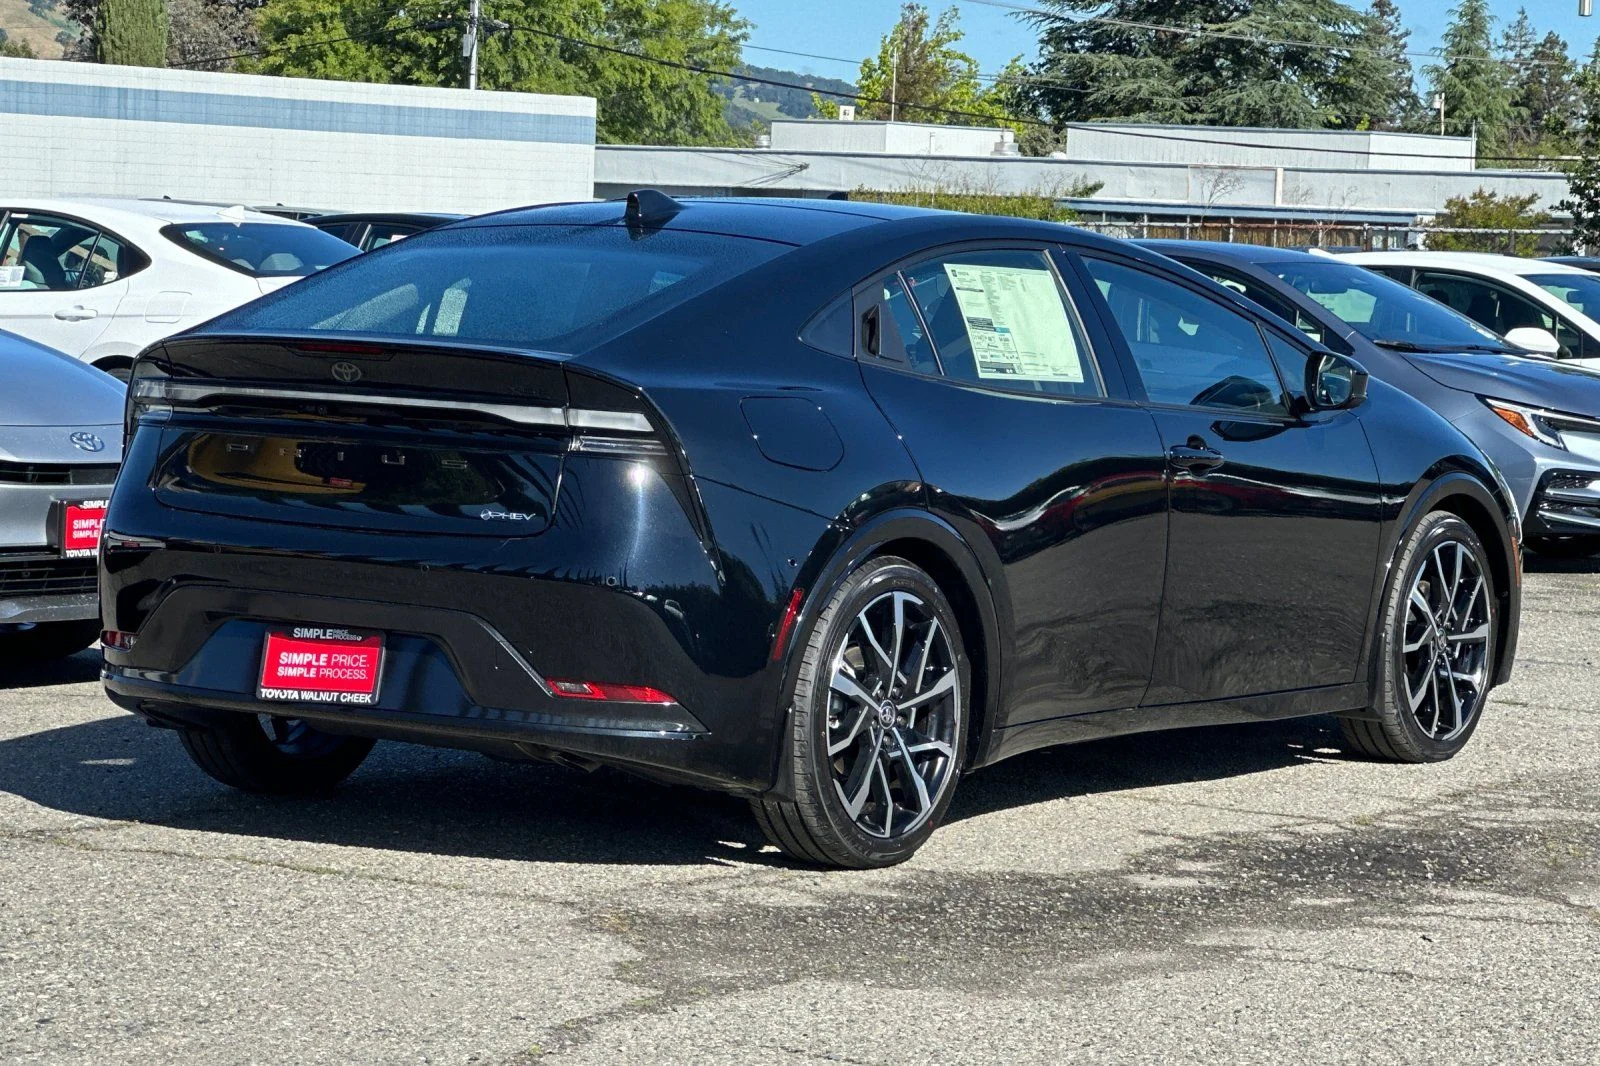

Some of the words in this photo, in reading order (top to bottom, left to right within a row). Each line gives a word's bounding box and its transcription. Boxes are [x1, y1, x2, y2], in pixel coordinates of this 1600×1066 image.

[293, 627, 333, 639] SIMPLE
[279, 652, 328, 666] SIMPLE
[331, 655, 370, 667] PRICE.
[277, 667, 316, 677] SIMPLE
[319, 669, 368, 680] PROCESS.
[261, 689, 299, 699] TOYOTA
[300, 691, 339, 702] WALNUT
[340, 694, 372, 703] CHEEK
